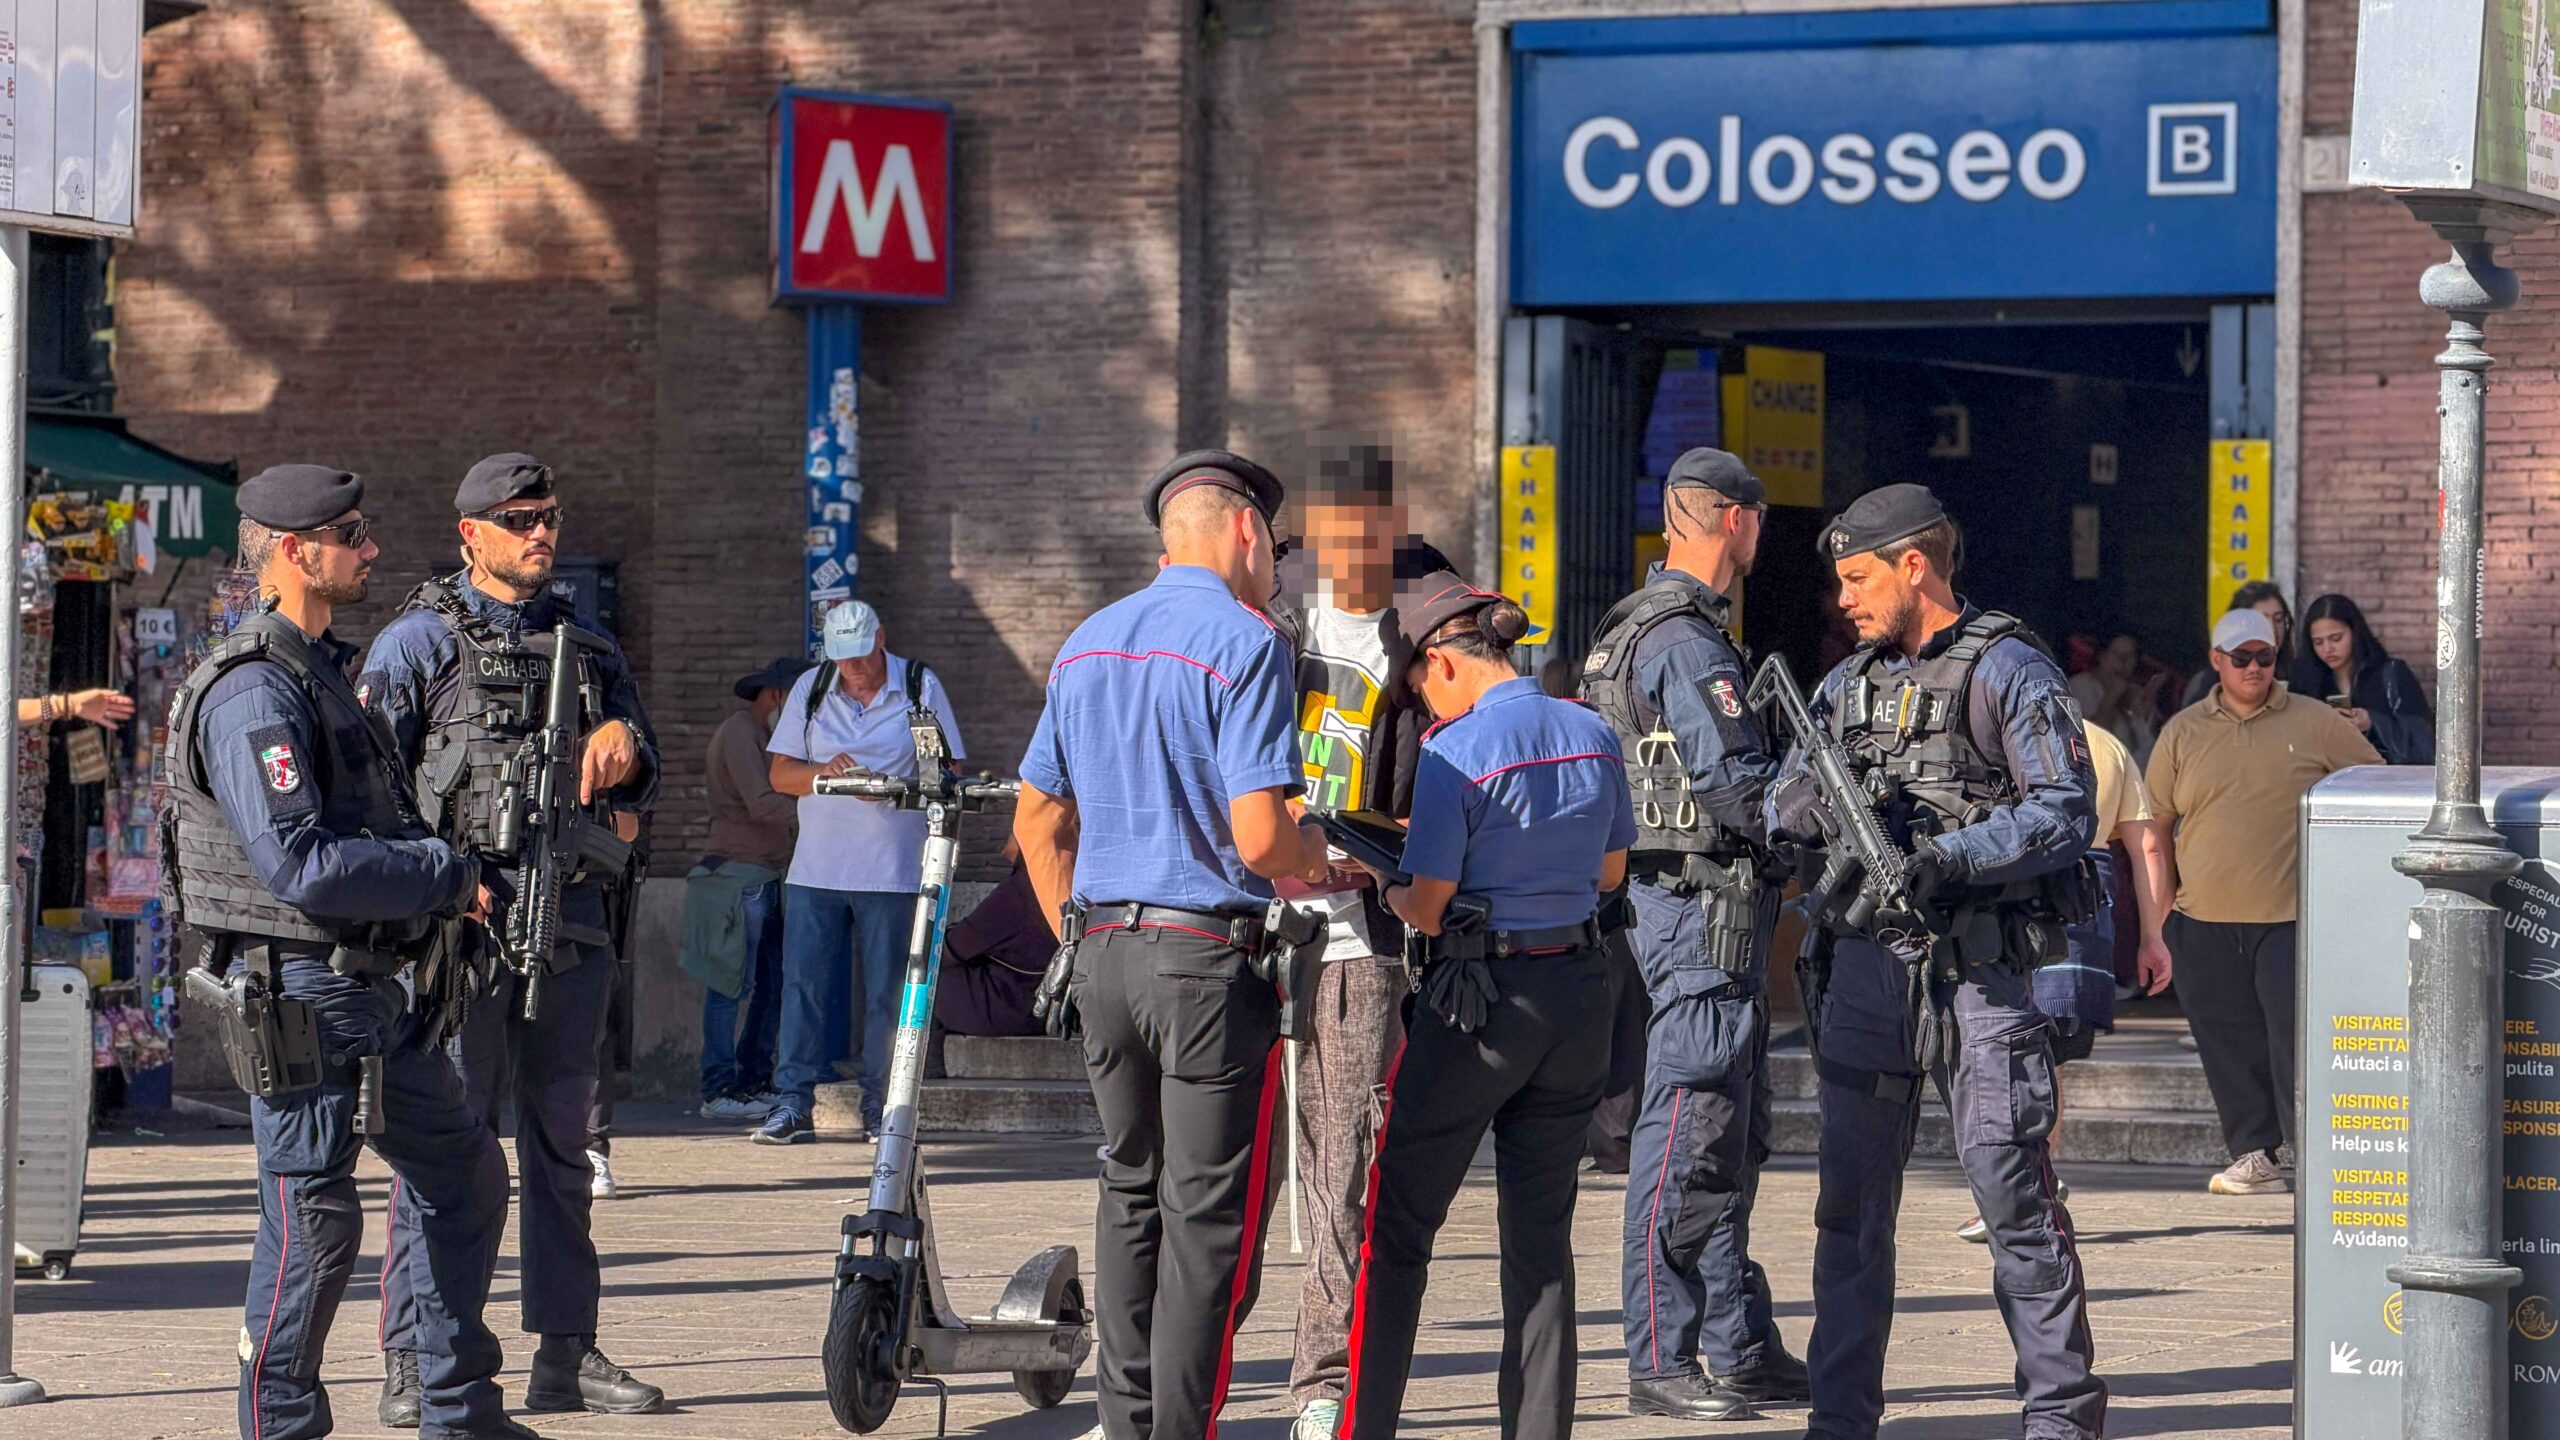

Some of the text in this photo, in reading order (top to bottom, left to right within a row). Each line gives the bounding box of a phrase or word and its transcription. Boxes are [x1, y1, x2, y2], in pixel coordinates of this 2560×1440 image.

[1563, 115, 2212, 209] Colosseo B
[801, 139, 936, 262] M
[1520, 451, 1537, 609] CHANGE
[139, 618, 158, 635] 10
[480, 656, 583, 682] CARABINI
[2522, 901, 2547, 919] FOR
[2332, 1015, 2403, 1031] VISITARE
[2332, 1036, 2409, 1053] RISPETTA
[2331, 1054, 2554, 1078] Aiutaci a pulita
[2331, 1093, 2399, 1110] VISITING
[2332, 1114, 2409, 1132] RESPECTI
[2331, 1134, 2371, 1155] Help
[2374, 1139, 2395, 1153] us
[2332, 1168, 2394, 1185] VISITAR
[2503, 1175, 2560, 1192] LACER.
[2331, 1229, 2408, 1248] Ayúdano
[2502, 1237, 2535, 1254] erla
